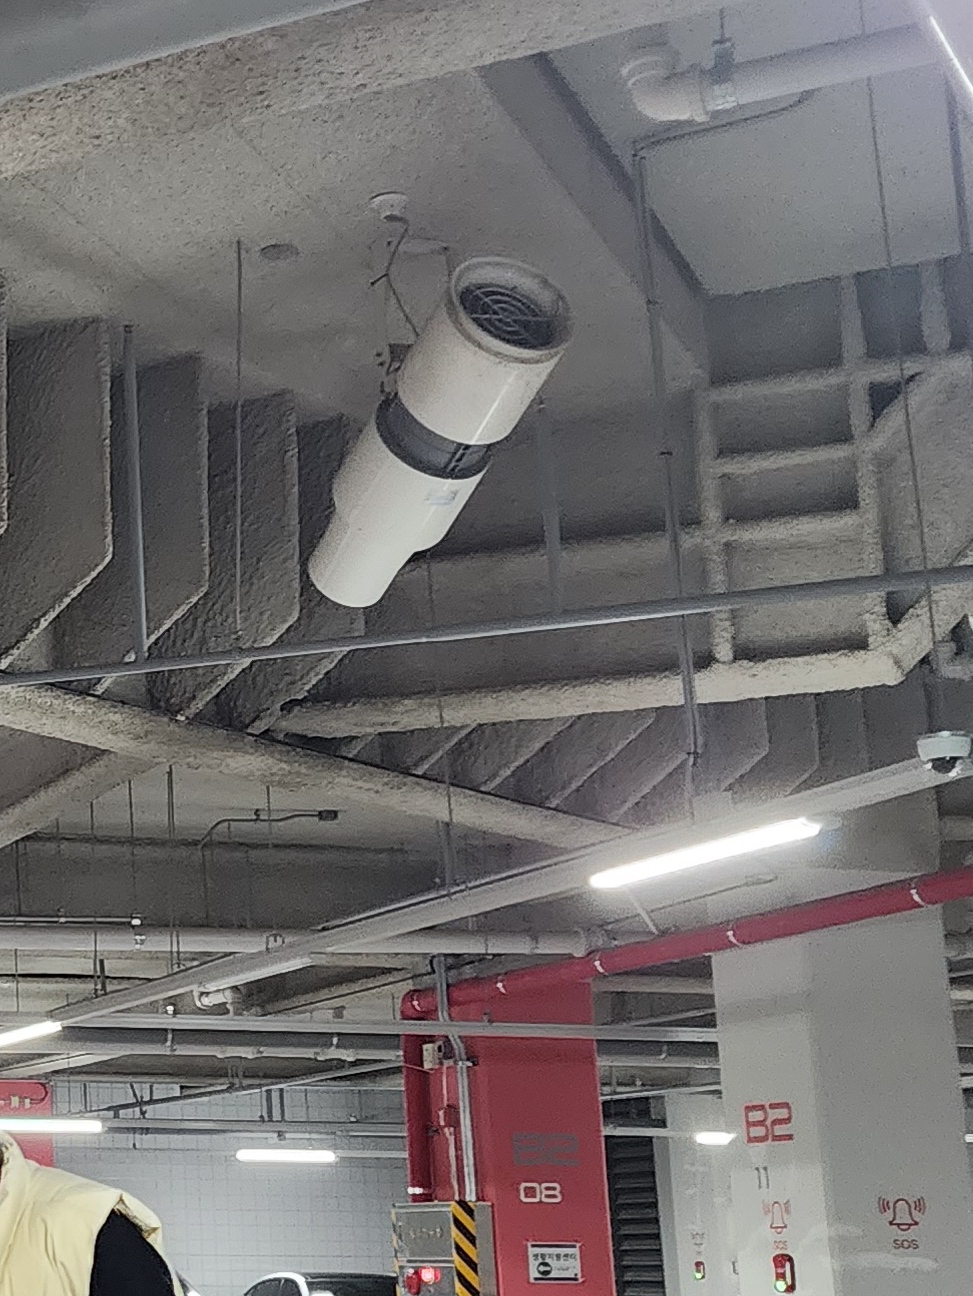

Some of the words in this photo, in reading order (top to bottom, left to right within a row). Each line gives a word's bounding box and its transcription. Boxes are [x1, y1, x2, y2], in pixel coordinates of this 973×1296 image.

[745, 1102, 794, 1143] B2
[513, 1133, 580, 1167] B2
[755, 1166, 769, 1189] 11
[519, 1182, 562, 1203] 08
[892, 1238, 920, 1250] SOS
